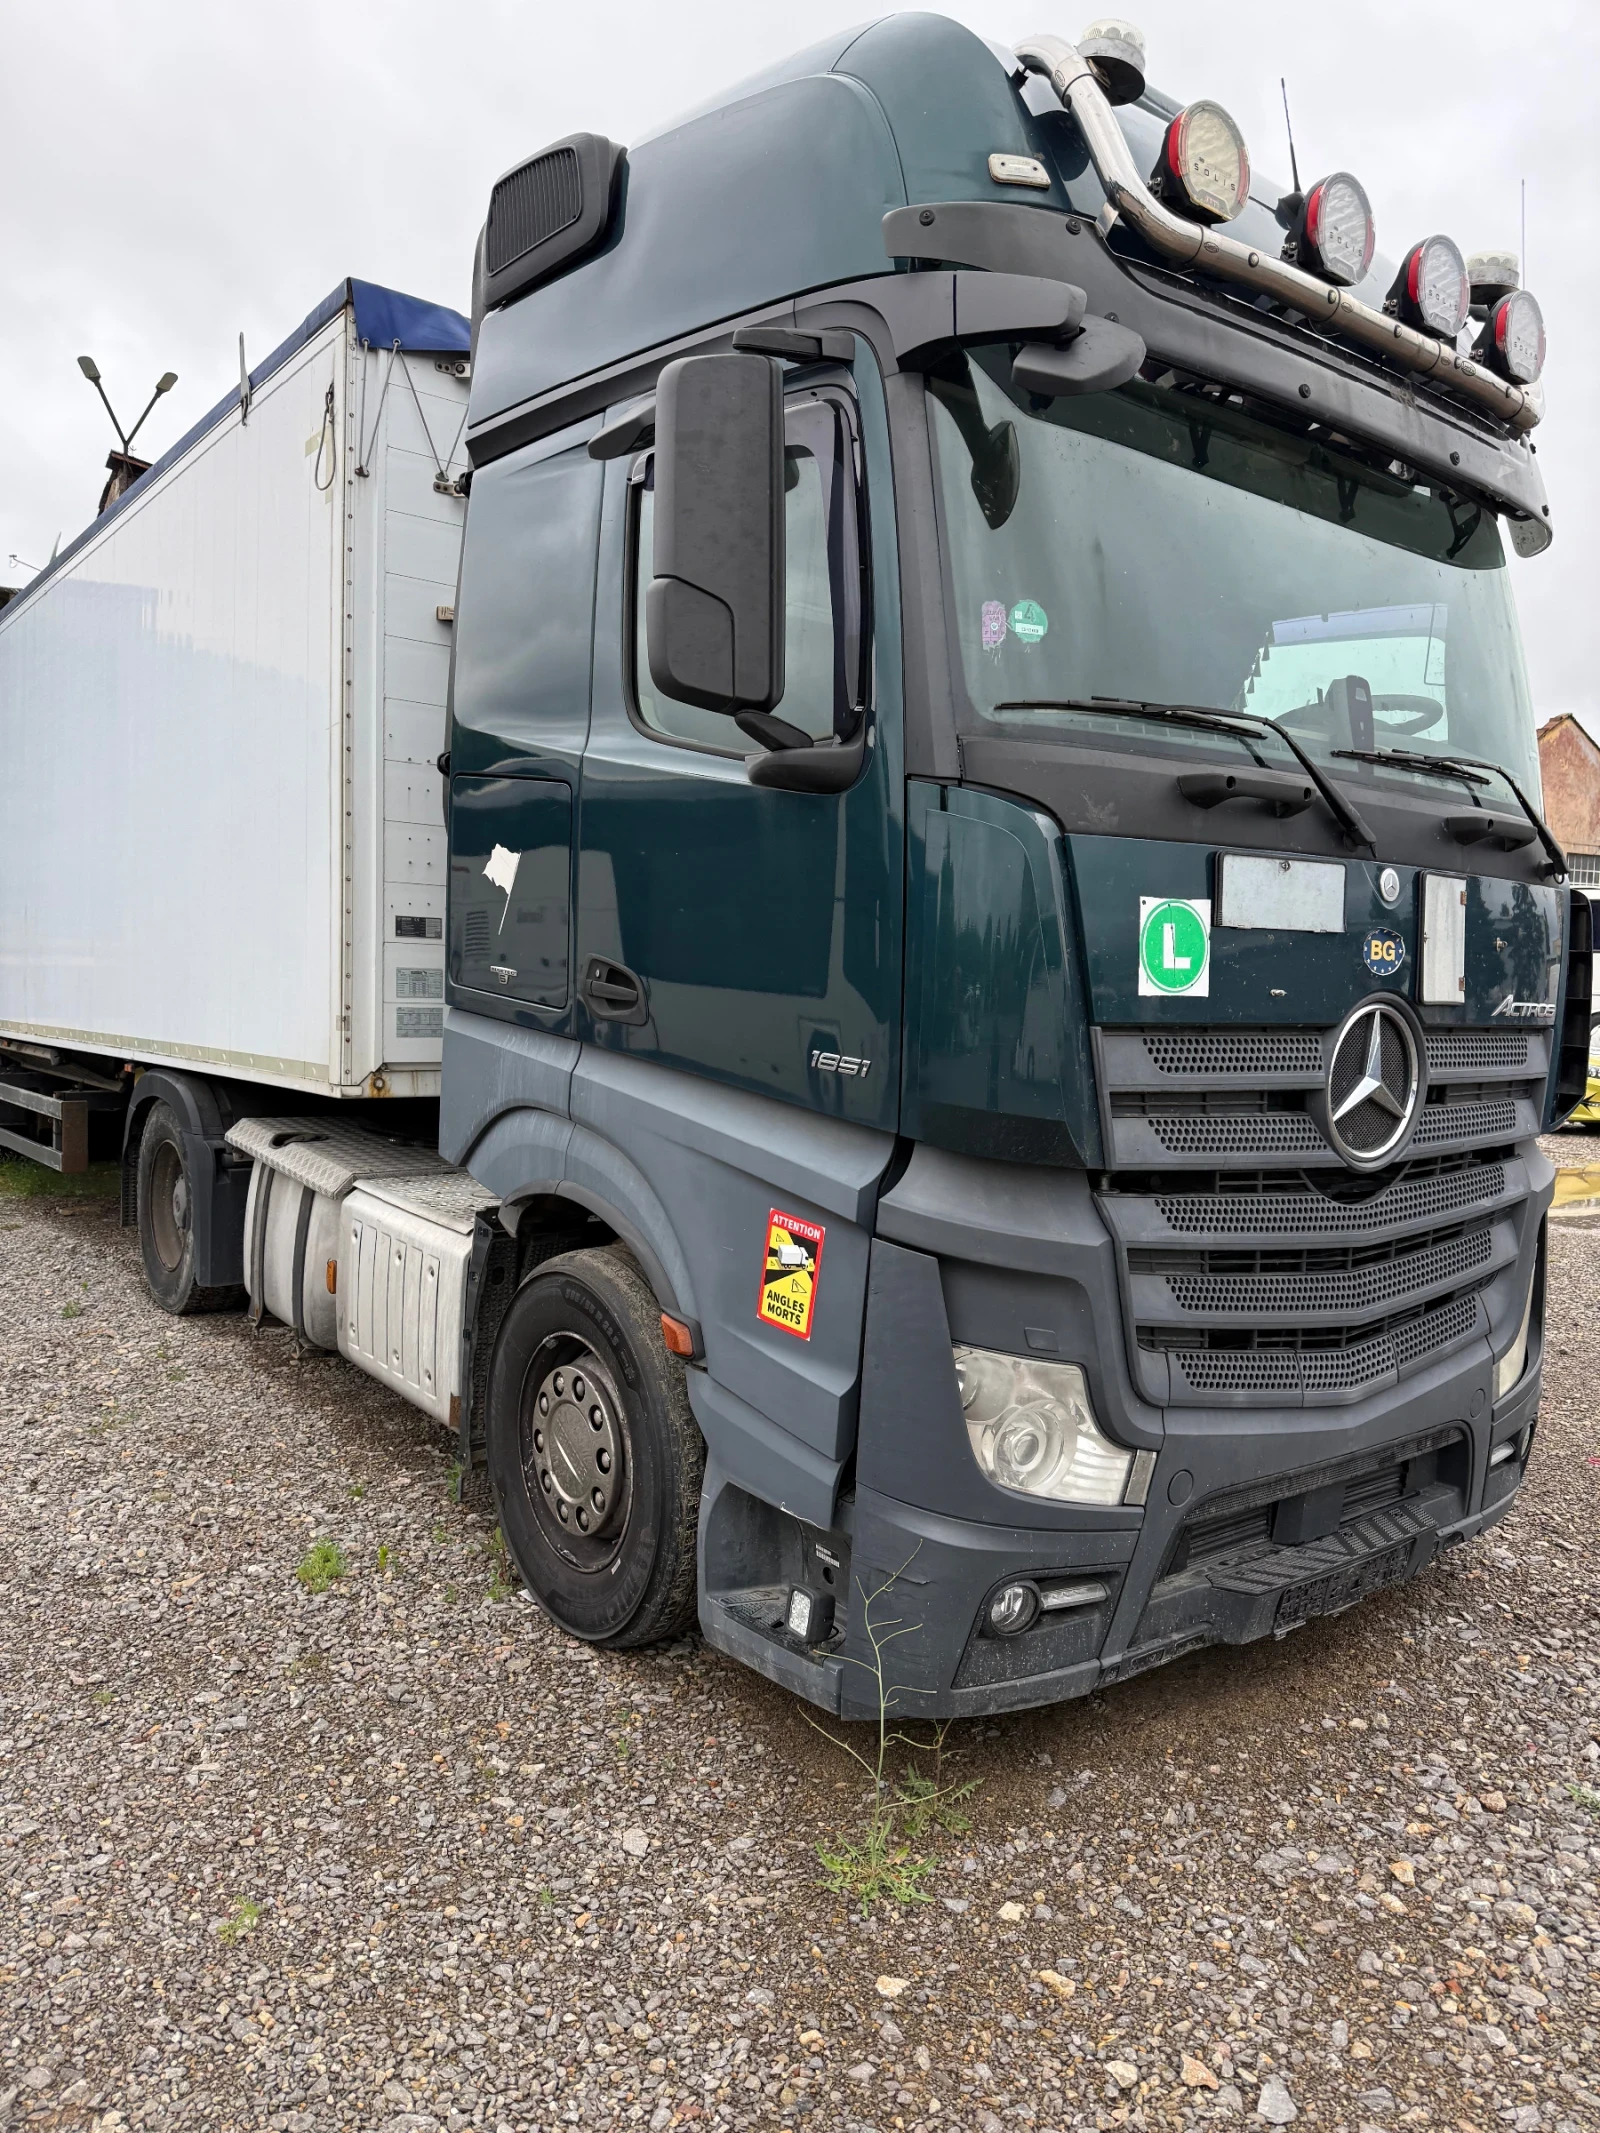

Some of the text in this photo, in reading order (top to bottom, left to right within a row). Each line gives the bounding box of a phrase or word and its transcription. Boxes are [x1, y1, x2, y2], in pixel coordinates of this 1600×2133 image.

[1193, 162, 1236, 192] SOLIS
[1329, 231, 1363, 257] SOLIS
[1163, 922, 1191, 969] L
[1370, 939, 1396, 962] BG
[1490, 994, 1556, 1018] ACTROS
[810, 1049, 872, 1078] 1851
[772, 1213, 821, 1240] ATTENTION
[766, 1289, 805, 1314] ANGLES
[767, 1301, 801, 1325] MORTS
